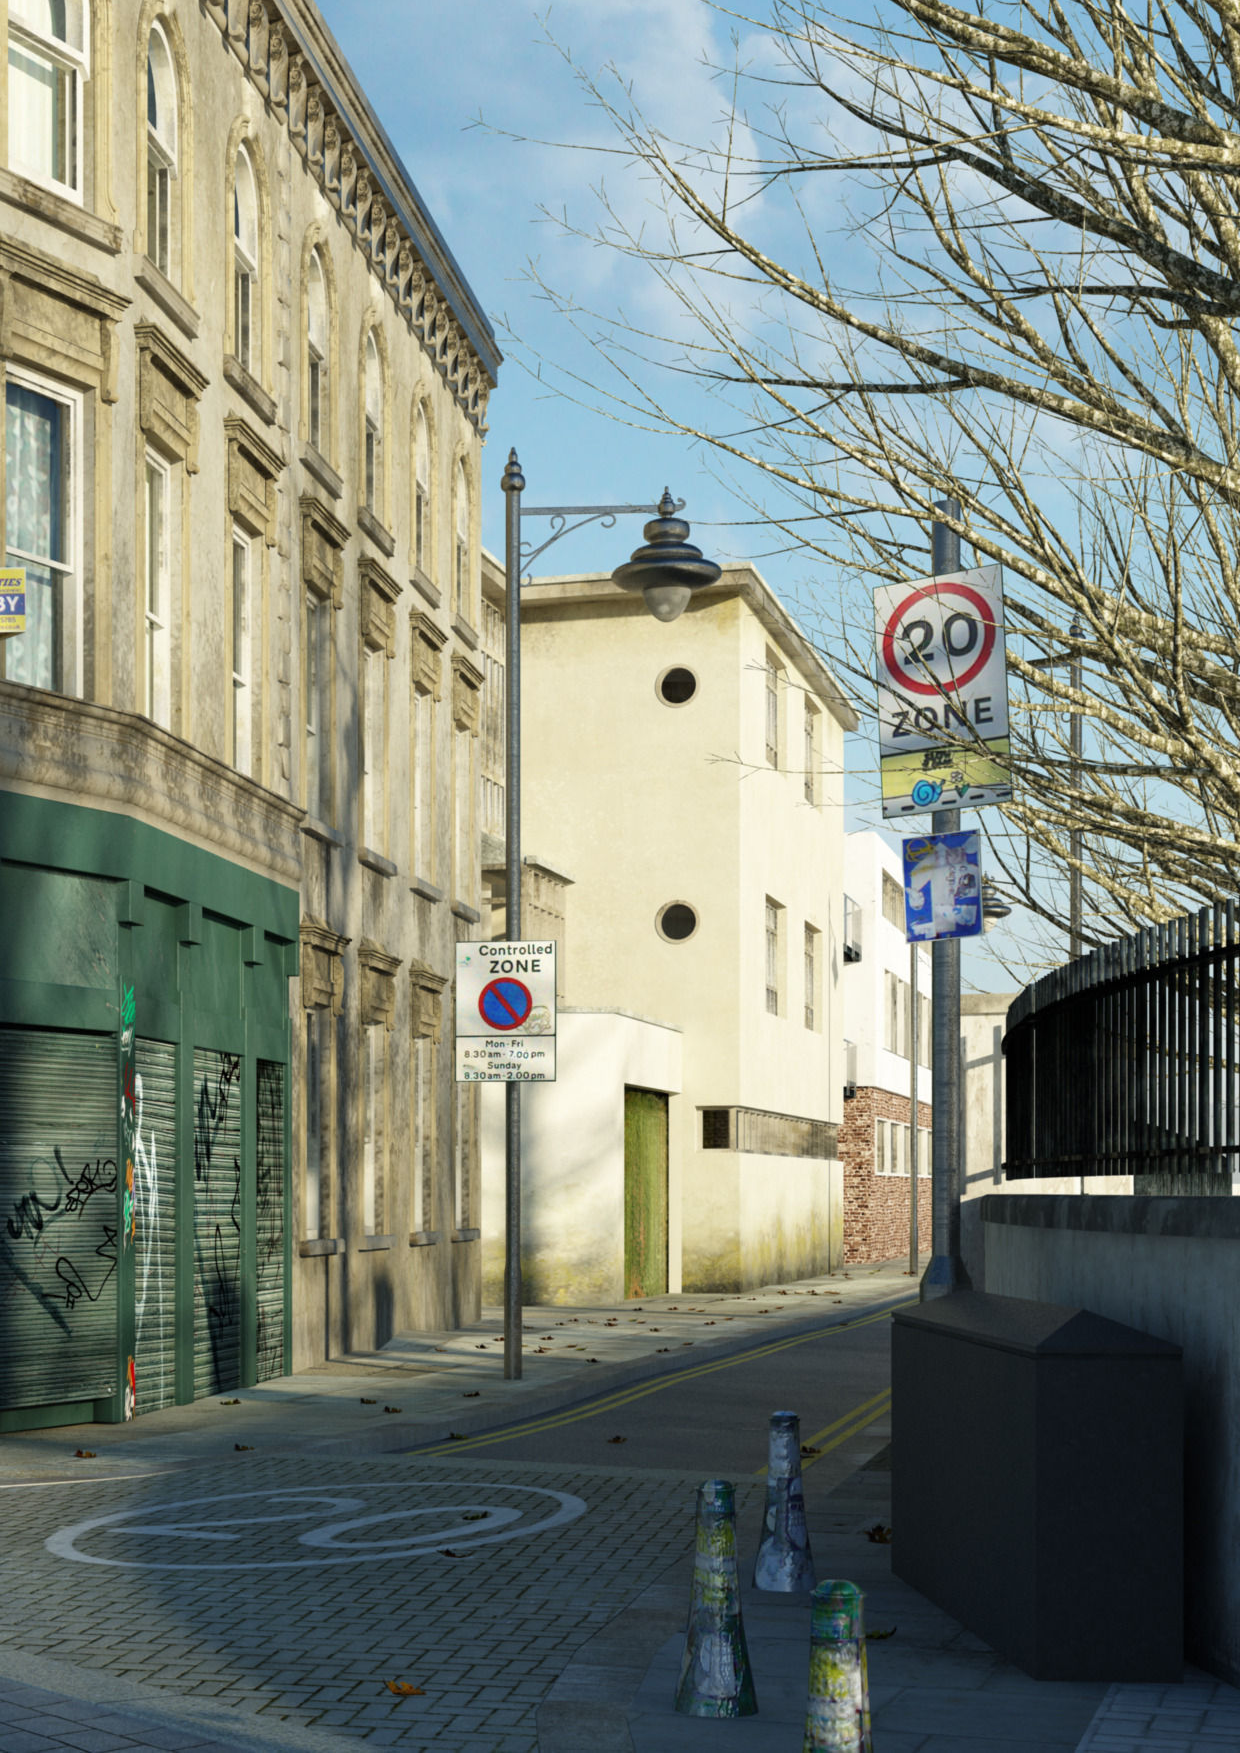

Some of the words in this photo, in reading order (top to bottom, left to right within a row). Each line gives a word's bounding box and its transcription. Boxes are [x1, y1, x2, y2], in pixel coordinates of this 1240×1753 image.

[902, 612, 979, 666] 20
[892, 696, 994, 738] ZONE
[479, 943, 552, 956] Controlled
[489, 959, 541, 974] ZONE
[488, 1061, 521, 1070] Sunday
[107, 1497, 523, 1548] 20
